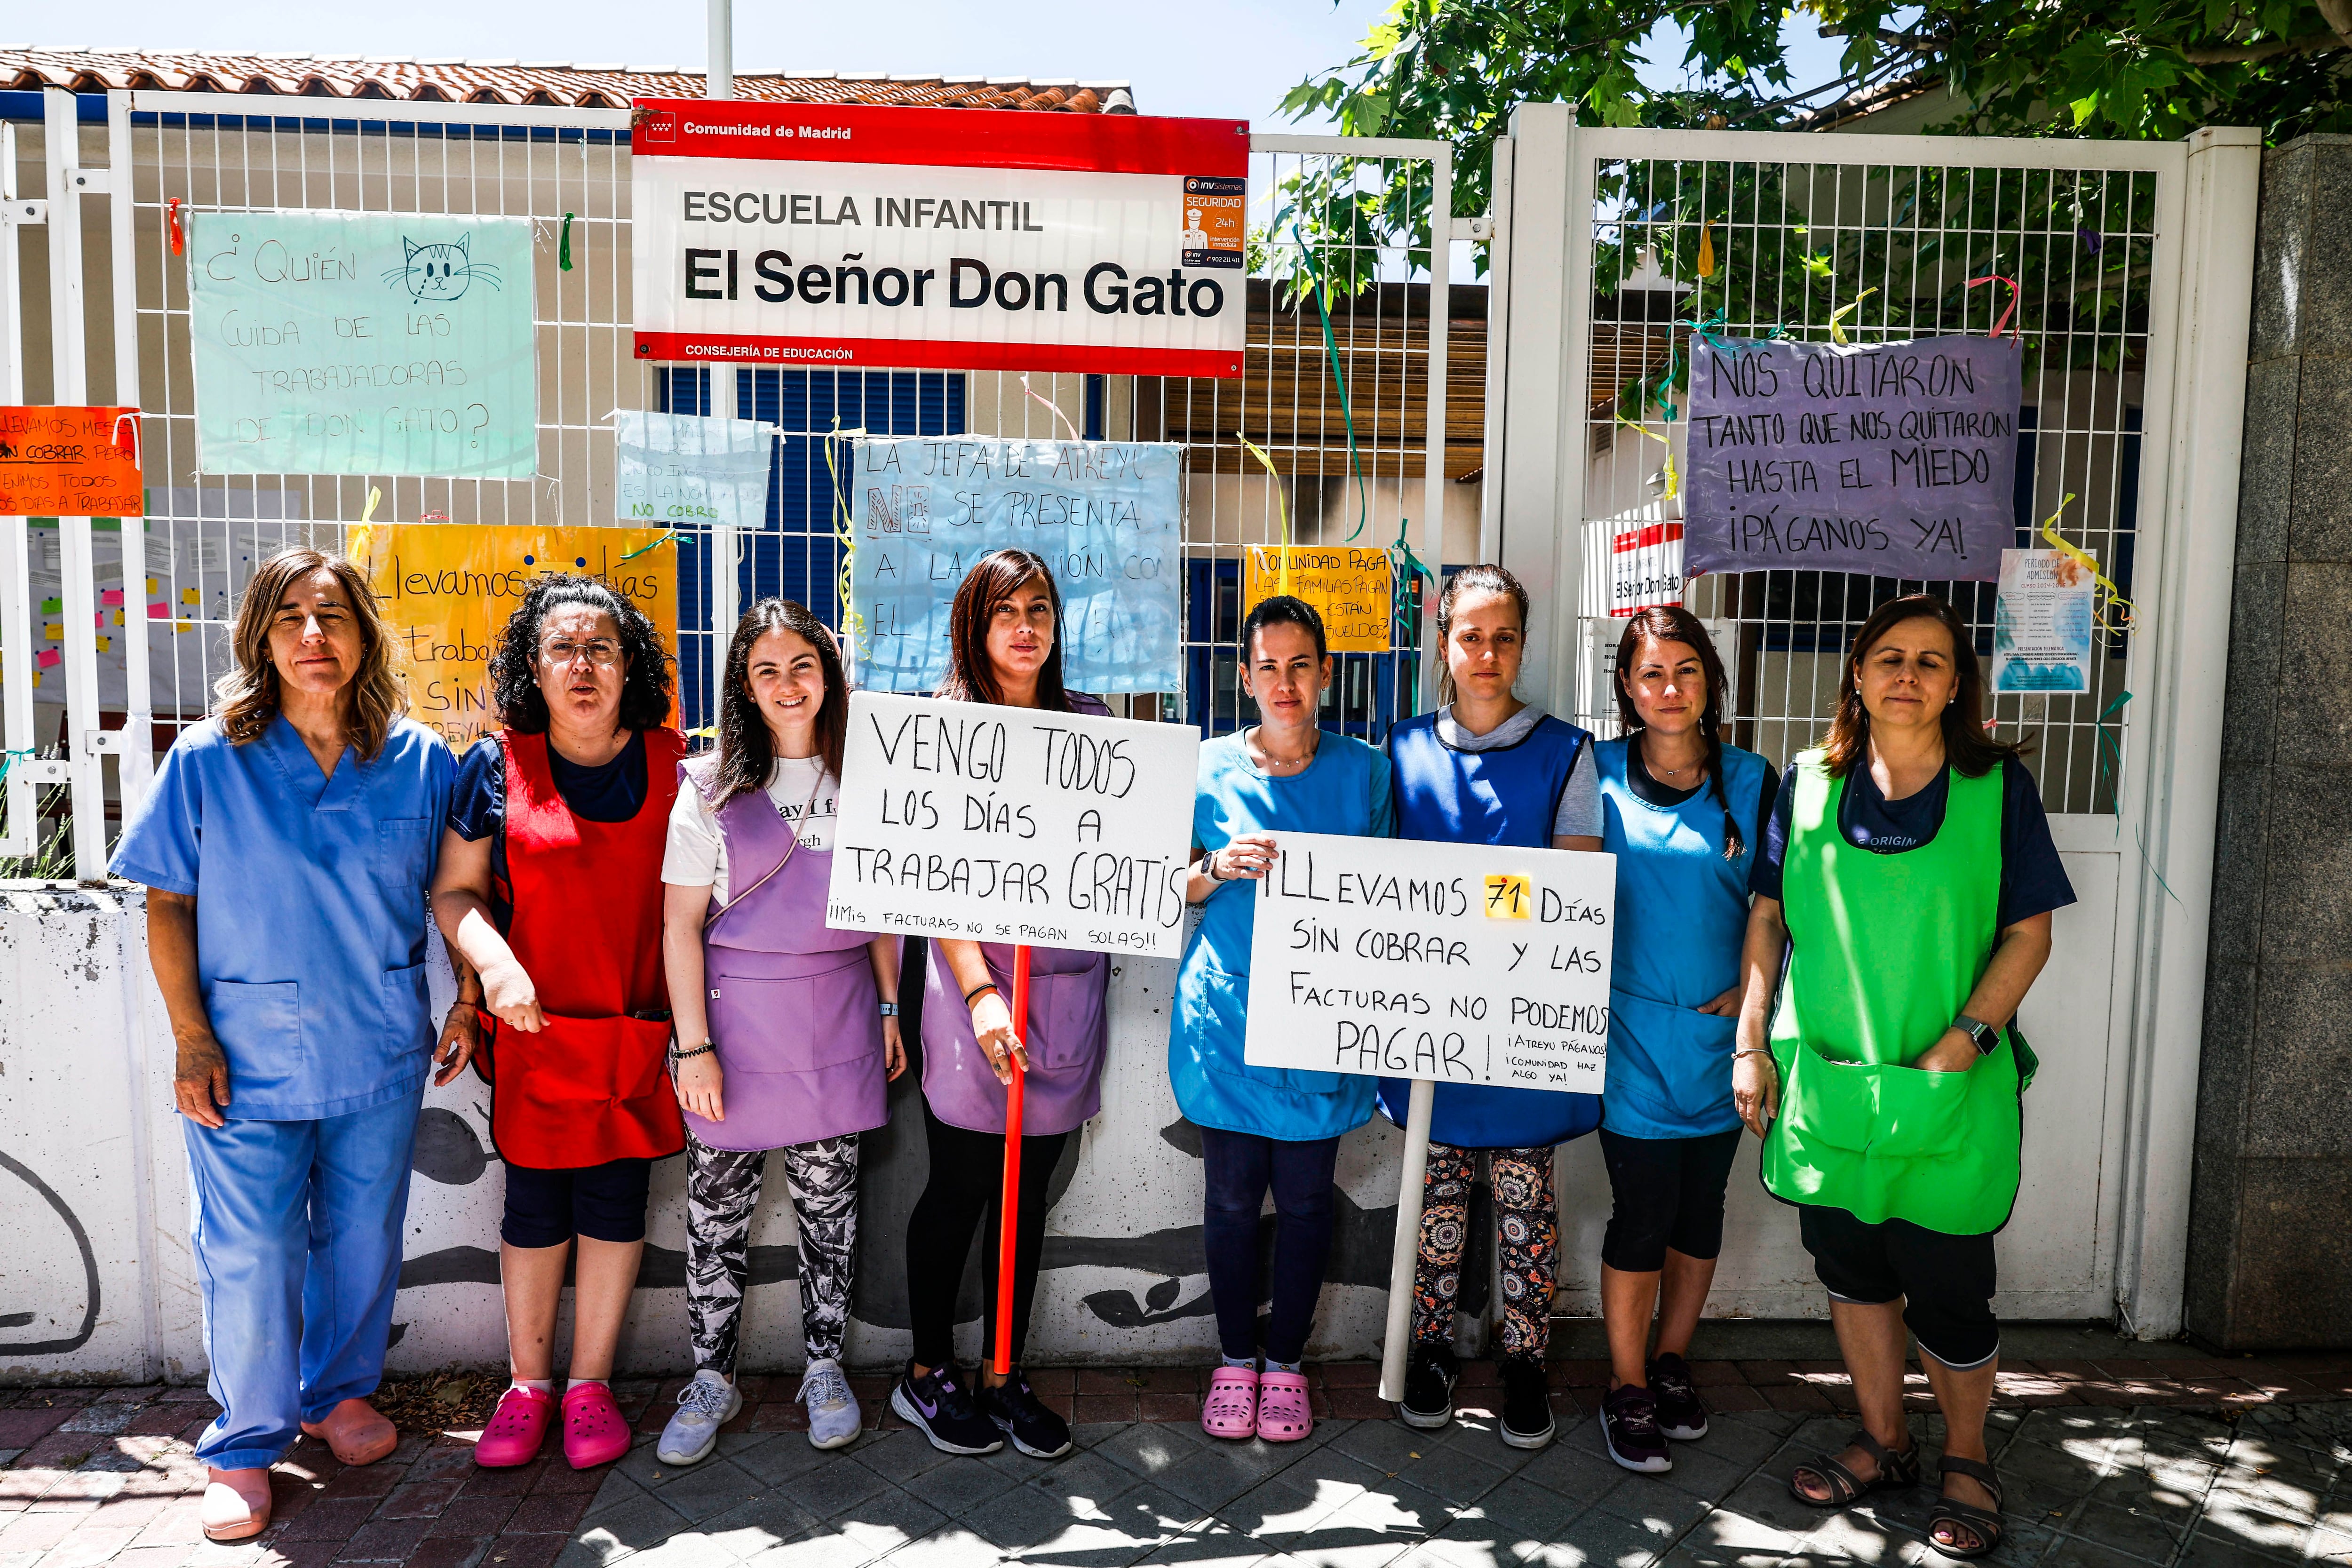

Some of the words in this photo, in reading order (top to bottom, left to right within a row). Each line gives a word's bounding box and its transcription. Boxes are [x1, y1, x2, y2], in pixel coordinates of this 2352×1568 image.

[683, 121, 771, 136] Comunidad
[775, 125, 794, 137] de
[799, 126, 851, 140] Madrid
[683, 191, 862, 226] ESCUELA
[875, 197, 1043, 232] INFANTIL
[1186, 197, 1241, 208] SEGURIDAD
[1216, 217, 1234, 227] 24h
[684, 247, 737, 300] El
[754, 252, 935, 307] Señor
[949, 258, 1067, 311] Don
[1083, 262, 1224, 319] Gato
[220, 309, 300, 347] CUIDA
[335, 315, 373, 339] DE
[406, 312, 451, 337] LAS
[685, 344, 761, 357] CONSEJERÍA
[764, 348, 779, 357] DE
[783, 347, 853, 359] EDUCACIÓN
[253, 360, 468, 396] TRABAJADORAS
[1712, 351, 1778, 399] NOS
[1804, 353, 1975, 399] QUITARON
[83, 419, 134, 437] MESES
[238, 418, 274, 443] DE
[306, 412, 366, 438] DON
[383, 403, 490, 449] GATO?
[673, 423, 727, 438] MADRE
[1692, 413, 1784, 448] TANTO
[1800, 413, 1841, 444] QUE
[1851, 412, 1891, 442] NOS
[1899, 407, 2010, 441] QUITARON
[93, 445, 135, 461] PERO
[866, 444, 901, 474] LA
[923, 443, 990, 479] JEFA
[1006, 445, 1031, 478] DE
[1052, 447, 1148, 481] ATREYU
[0, 473, 49, 491] ENIMOS
[58, 474, 117, 487] TODOS
[667, 464, 735, 479] INGRESO
[1728, 460, 1818, 493] HASTA
[1840, 459, 1873, 488] EL
[1891, 443, 1989, 488] MIEDO
[0, 497, 16, 511] OS
[21, 496, 55, 509] DÍAS
[59, 496, 68, 509] A
[74, 492, 141, 511] TRABAJAR
[623, 484, 645, 497] ES
[656, 483, 673, 499] LA
[632, 502, 654, 517] NO
[667, 505, 718, 518] COBRO
[867, 485, 930, 533] NO
[947, 491, 984, 525] SE
[1004, 492, 1141, 529] PRESENTA
[1729, 504, 1889, 554] ¡PÁGANOS
[1910, 517, 1968, 560] YA!
[875, 554, 897, 579] A
[930, 552, 962, 580] LA
[1125, 554, 1172, 581] CON
[1349, 549, 1386, 572] PAGA
[2025, 558, 2050, 568] PERIODO
[2052, 558, 2059, 568] DE
[2026, 569, 2058, 580] ADMISIÓN
[367, 554, 525, 599] Llevamos
[1296, 574, 1352, 595] FAMILIAS
[1353, 575, 1387, 595] PAGAN
[1616, 582, 1622, 598] El
[1645, 578, 1660, 594] Don
[1663, 573, 1679, 591] Gato
[875, 604, 911, 637] EL
[1325, 601, 1371, 616] ESTÁN
[1325, 618, 1388, 640] SUELDOS?
[422, 677, 486, 711] SIN
[871, 713, 1005, 783] VENGO
[1033, 726, 1135, 798] TODOS
[882, 788, 938, 829] LOS
[964, 791, 1036, 839] DÍAS
[1078, 809, 1101, 843] A
[845, 846, 1049, 904] TRABAJAR
[1069, 852, 1186, 929] GRATIS
[1488, 882, 1522, 914] 71
[1541, 887, 1606, 925] DÍAS
[883, 913, 959, 931] FACTURAS
[967, 922, 983, 934] NO
[994, 924, 1011, 937] SE
[1019, 924, 1067, 941] PAGAN
[1088, 930, 1156, 950] SOLAS!!
[1290, 917, 1339, 953] SIN
[1356, 929, 1470, 966] COBRAR
[1508, 943, 1528, 972] Y
[1550, 944, 1602, 973] LAS
[1291, 971, 1430, 1014] FACTURAS
[1450, 996, 1487, 1020] NO
[1511, 997, 1609, 1035] PODEMOS
[1336, 1020, 1491, 1081] PAGAR!
[1506, 1053, 1567, 1069] ¡COMUNIDAD
[1577, 1061, 1596, 1071] HAZ
[1561, 1039, 1607, 1059] PÁGANOS!
[1512, 1069, 1537, 1079] ALGO
[1549, 1073, 1567, 1086] YA!
